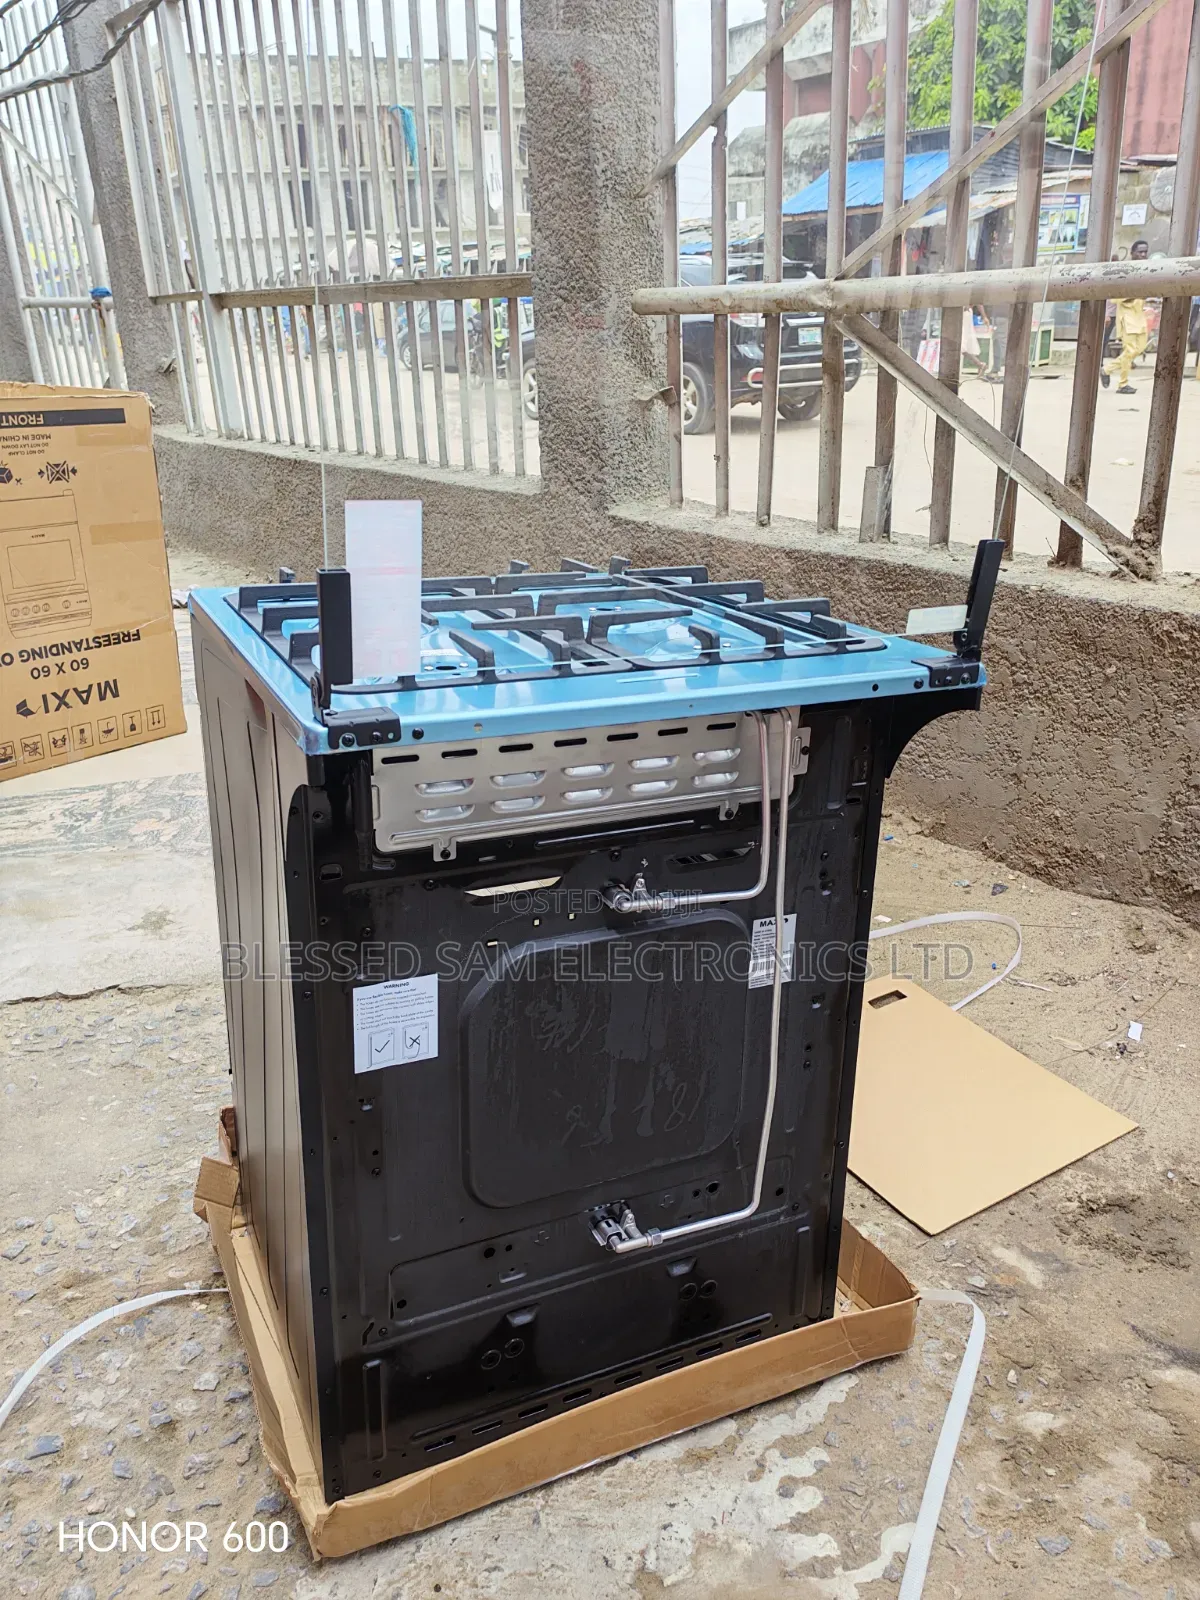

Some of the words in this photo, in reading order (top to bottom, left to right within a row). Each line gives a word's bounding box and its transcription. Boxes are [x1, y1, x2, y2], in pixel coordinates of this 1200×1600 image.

[1, 414, 44, 425] FRONT
[31, 433, 51, 441] MADE
[18, 629, 141, 663] FREESTANDING
[70, 657, 89, 672] 60
[30, 665, 51, 680] 60
[41, 678, 120, 714] MAXI
[383, 981, 410, 989] WARNING
